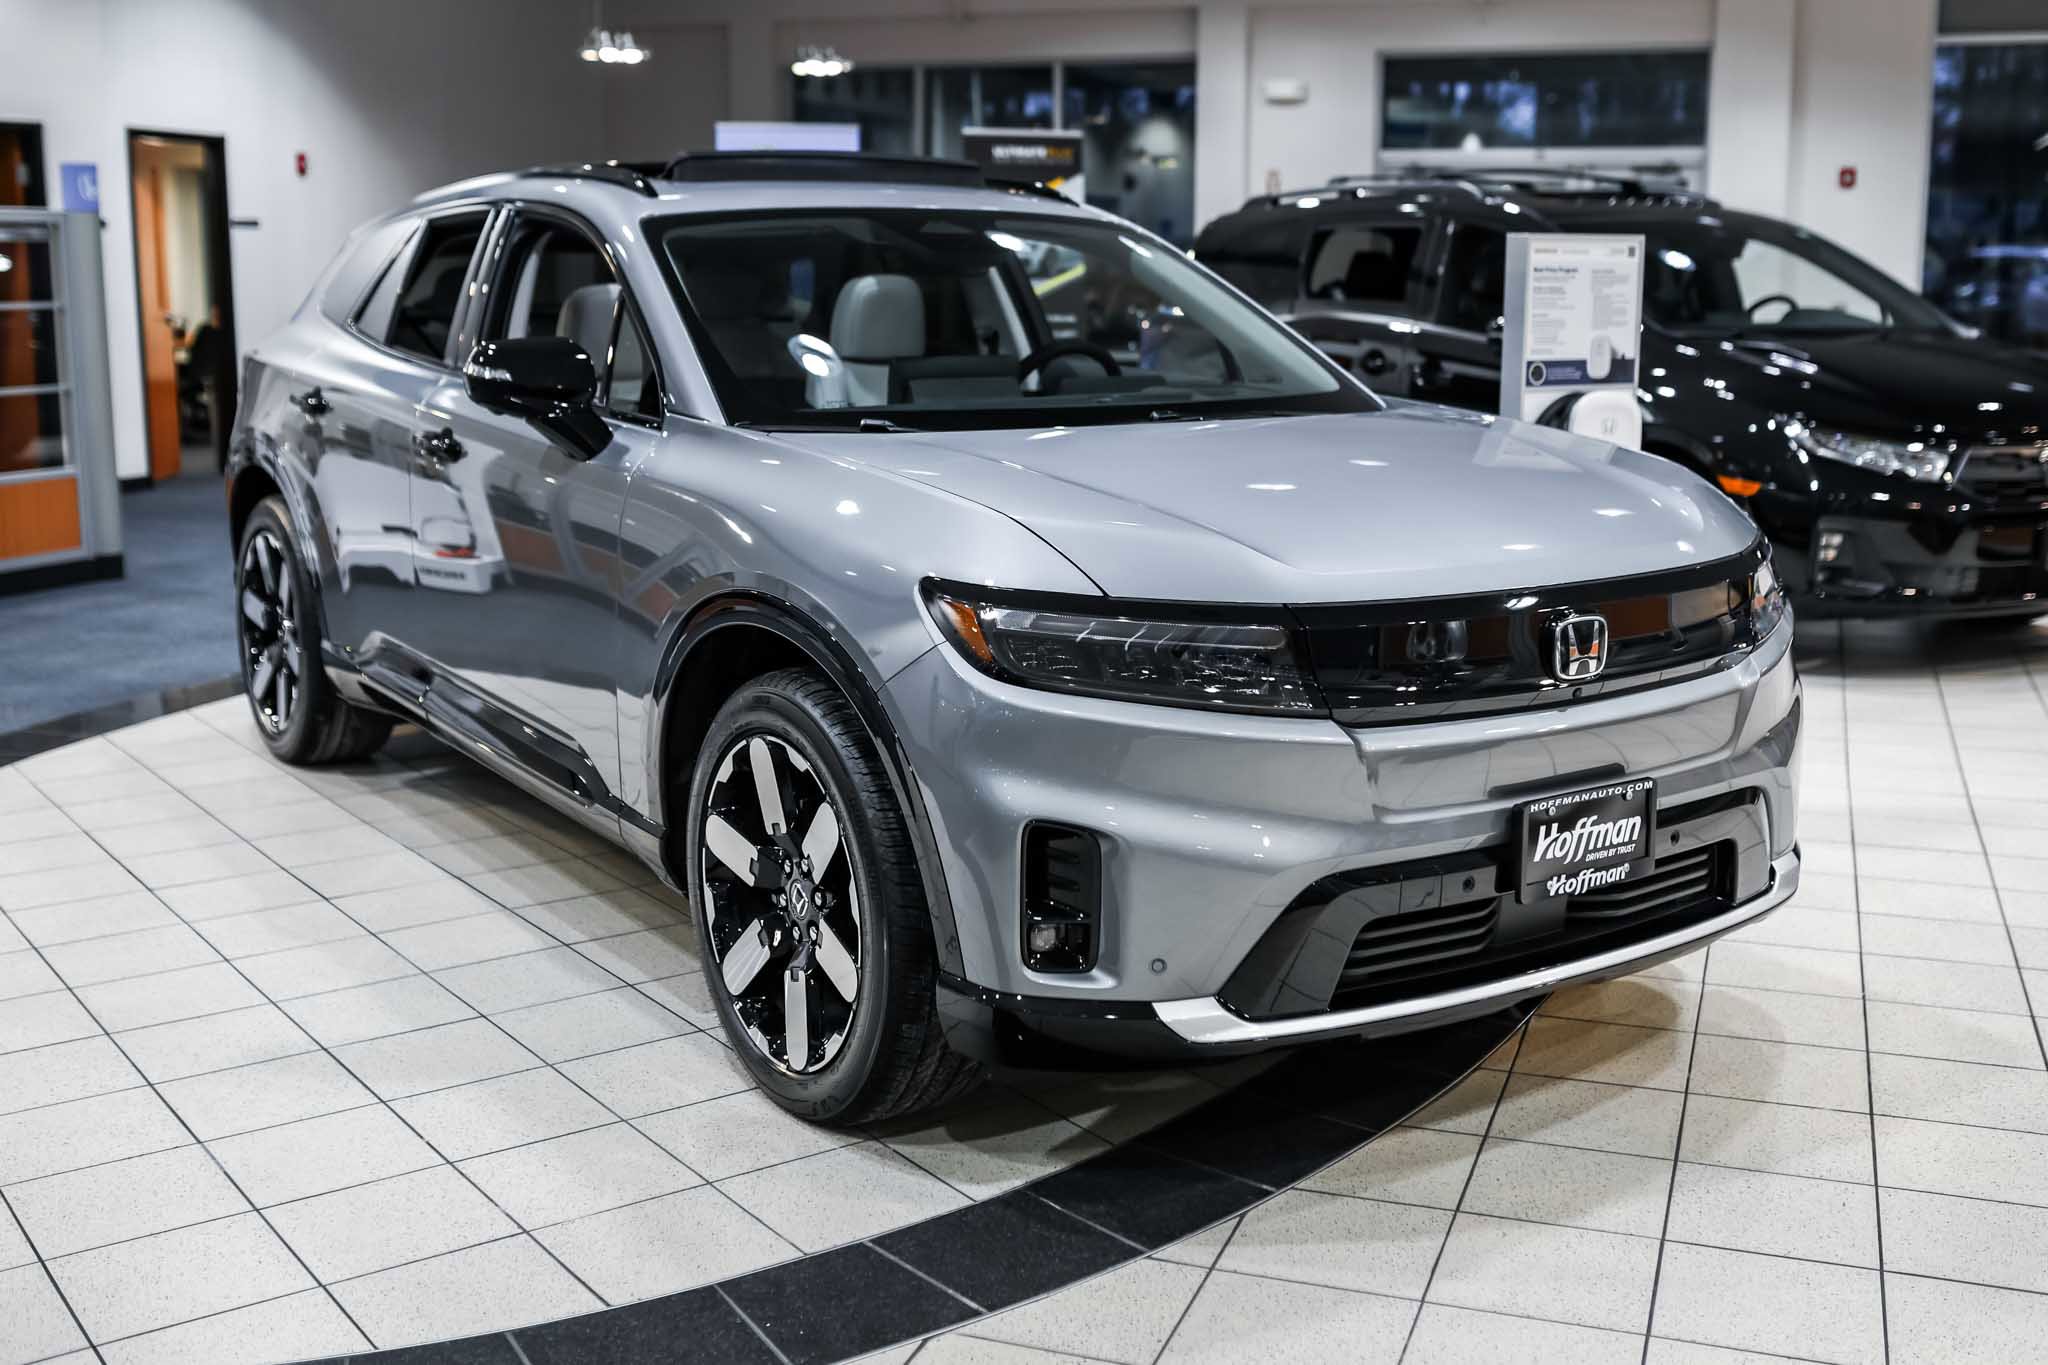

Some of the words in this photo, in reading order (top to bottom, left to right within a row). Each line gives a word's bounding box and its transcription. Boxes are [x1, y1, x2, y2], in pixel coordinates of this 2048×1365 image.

[1530, 781, 1653, 812] HOFFMANAUTO.COM
[1533, 815, 1642, 864] Hoffman
[1585, 849, 1609, 862] DRIVEN
[1608, 847, 1617, 857] BY
[1617, 843, 1636, 855] TRUST
[1549, 866, 1627, 896] Hoffman
